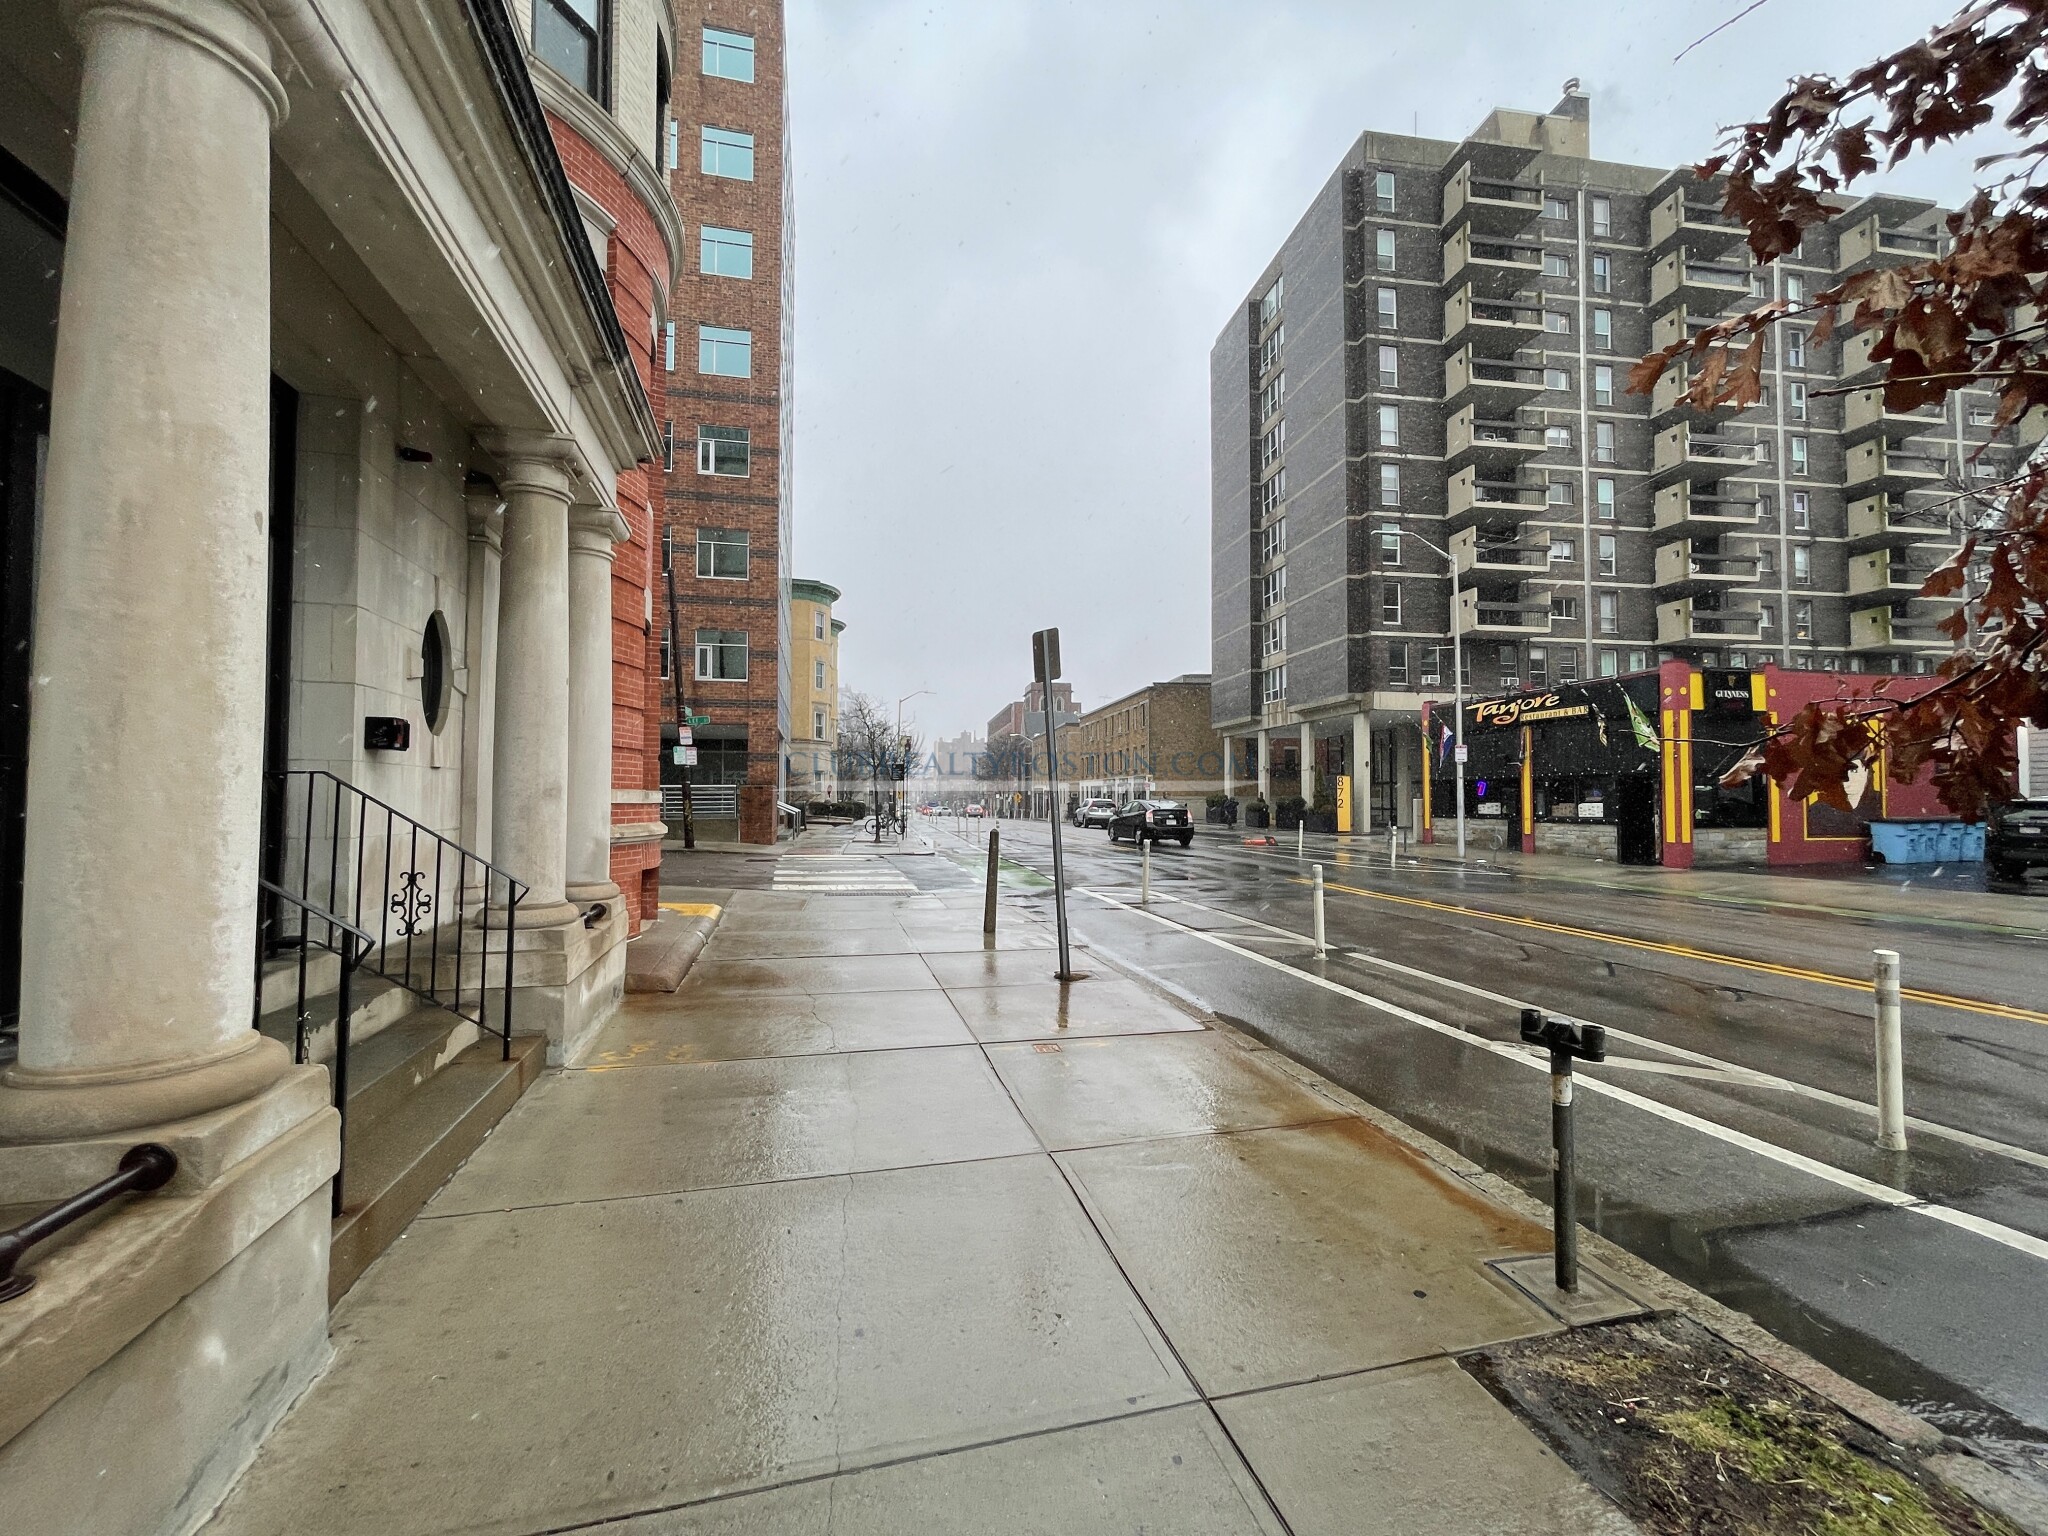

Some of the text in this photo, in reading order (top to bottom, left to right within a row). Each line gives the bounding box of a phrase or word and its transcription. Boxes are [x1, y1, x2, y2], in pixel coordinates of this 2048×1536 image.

[1715, 690, 1749, 699] GUINNESS
[1465, 693, 1560, 725] Tanjore
[1563, 708, 1569, 716] &
[1571, 705, 1589, 714] BAR
